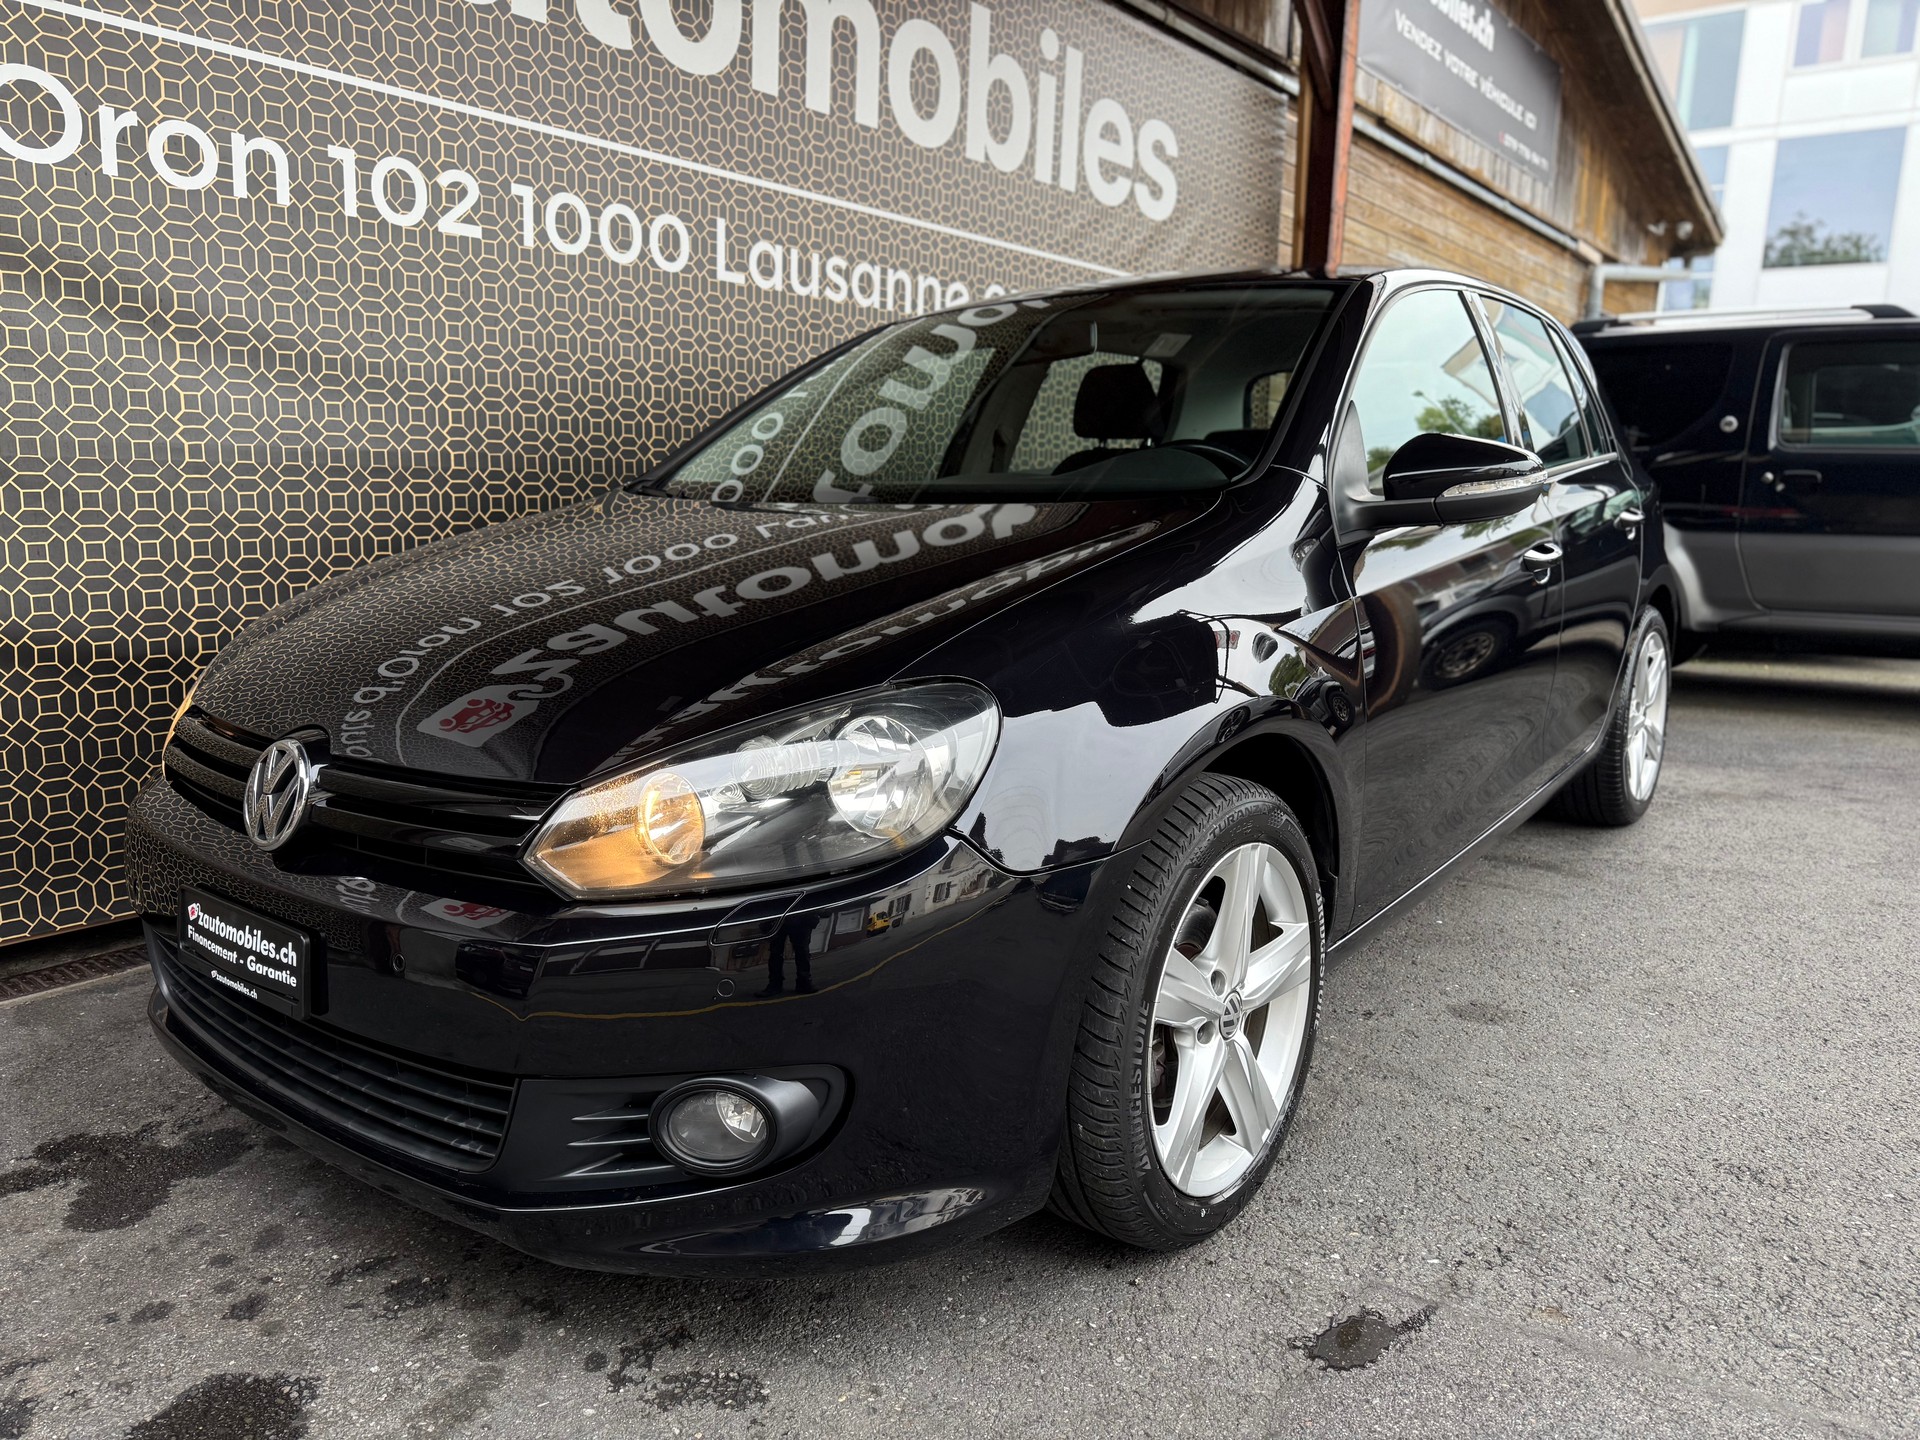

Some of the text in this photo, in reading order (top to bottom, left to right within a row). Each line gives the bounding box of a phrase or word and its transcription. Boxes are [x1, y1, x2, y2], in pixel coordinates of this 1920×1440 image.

[1394, 8, 1443, 62] VENDEZ
[1444, 48, 1479, 89] VOTRE
[0, 63, 970, 317] Oron 102 1000 Lausanne
[188, 925, 237, 964] Financement
[246, 955, 297, 987] Garantie
[197, 911, 297, 967] zautomobiles.ch
[216, 973, 258, 999] zautomobiles.ch
